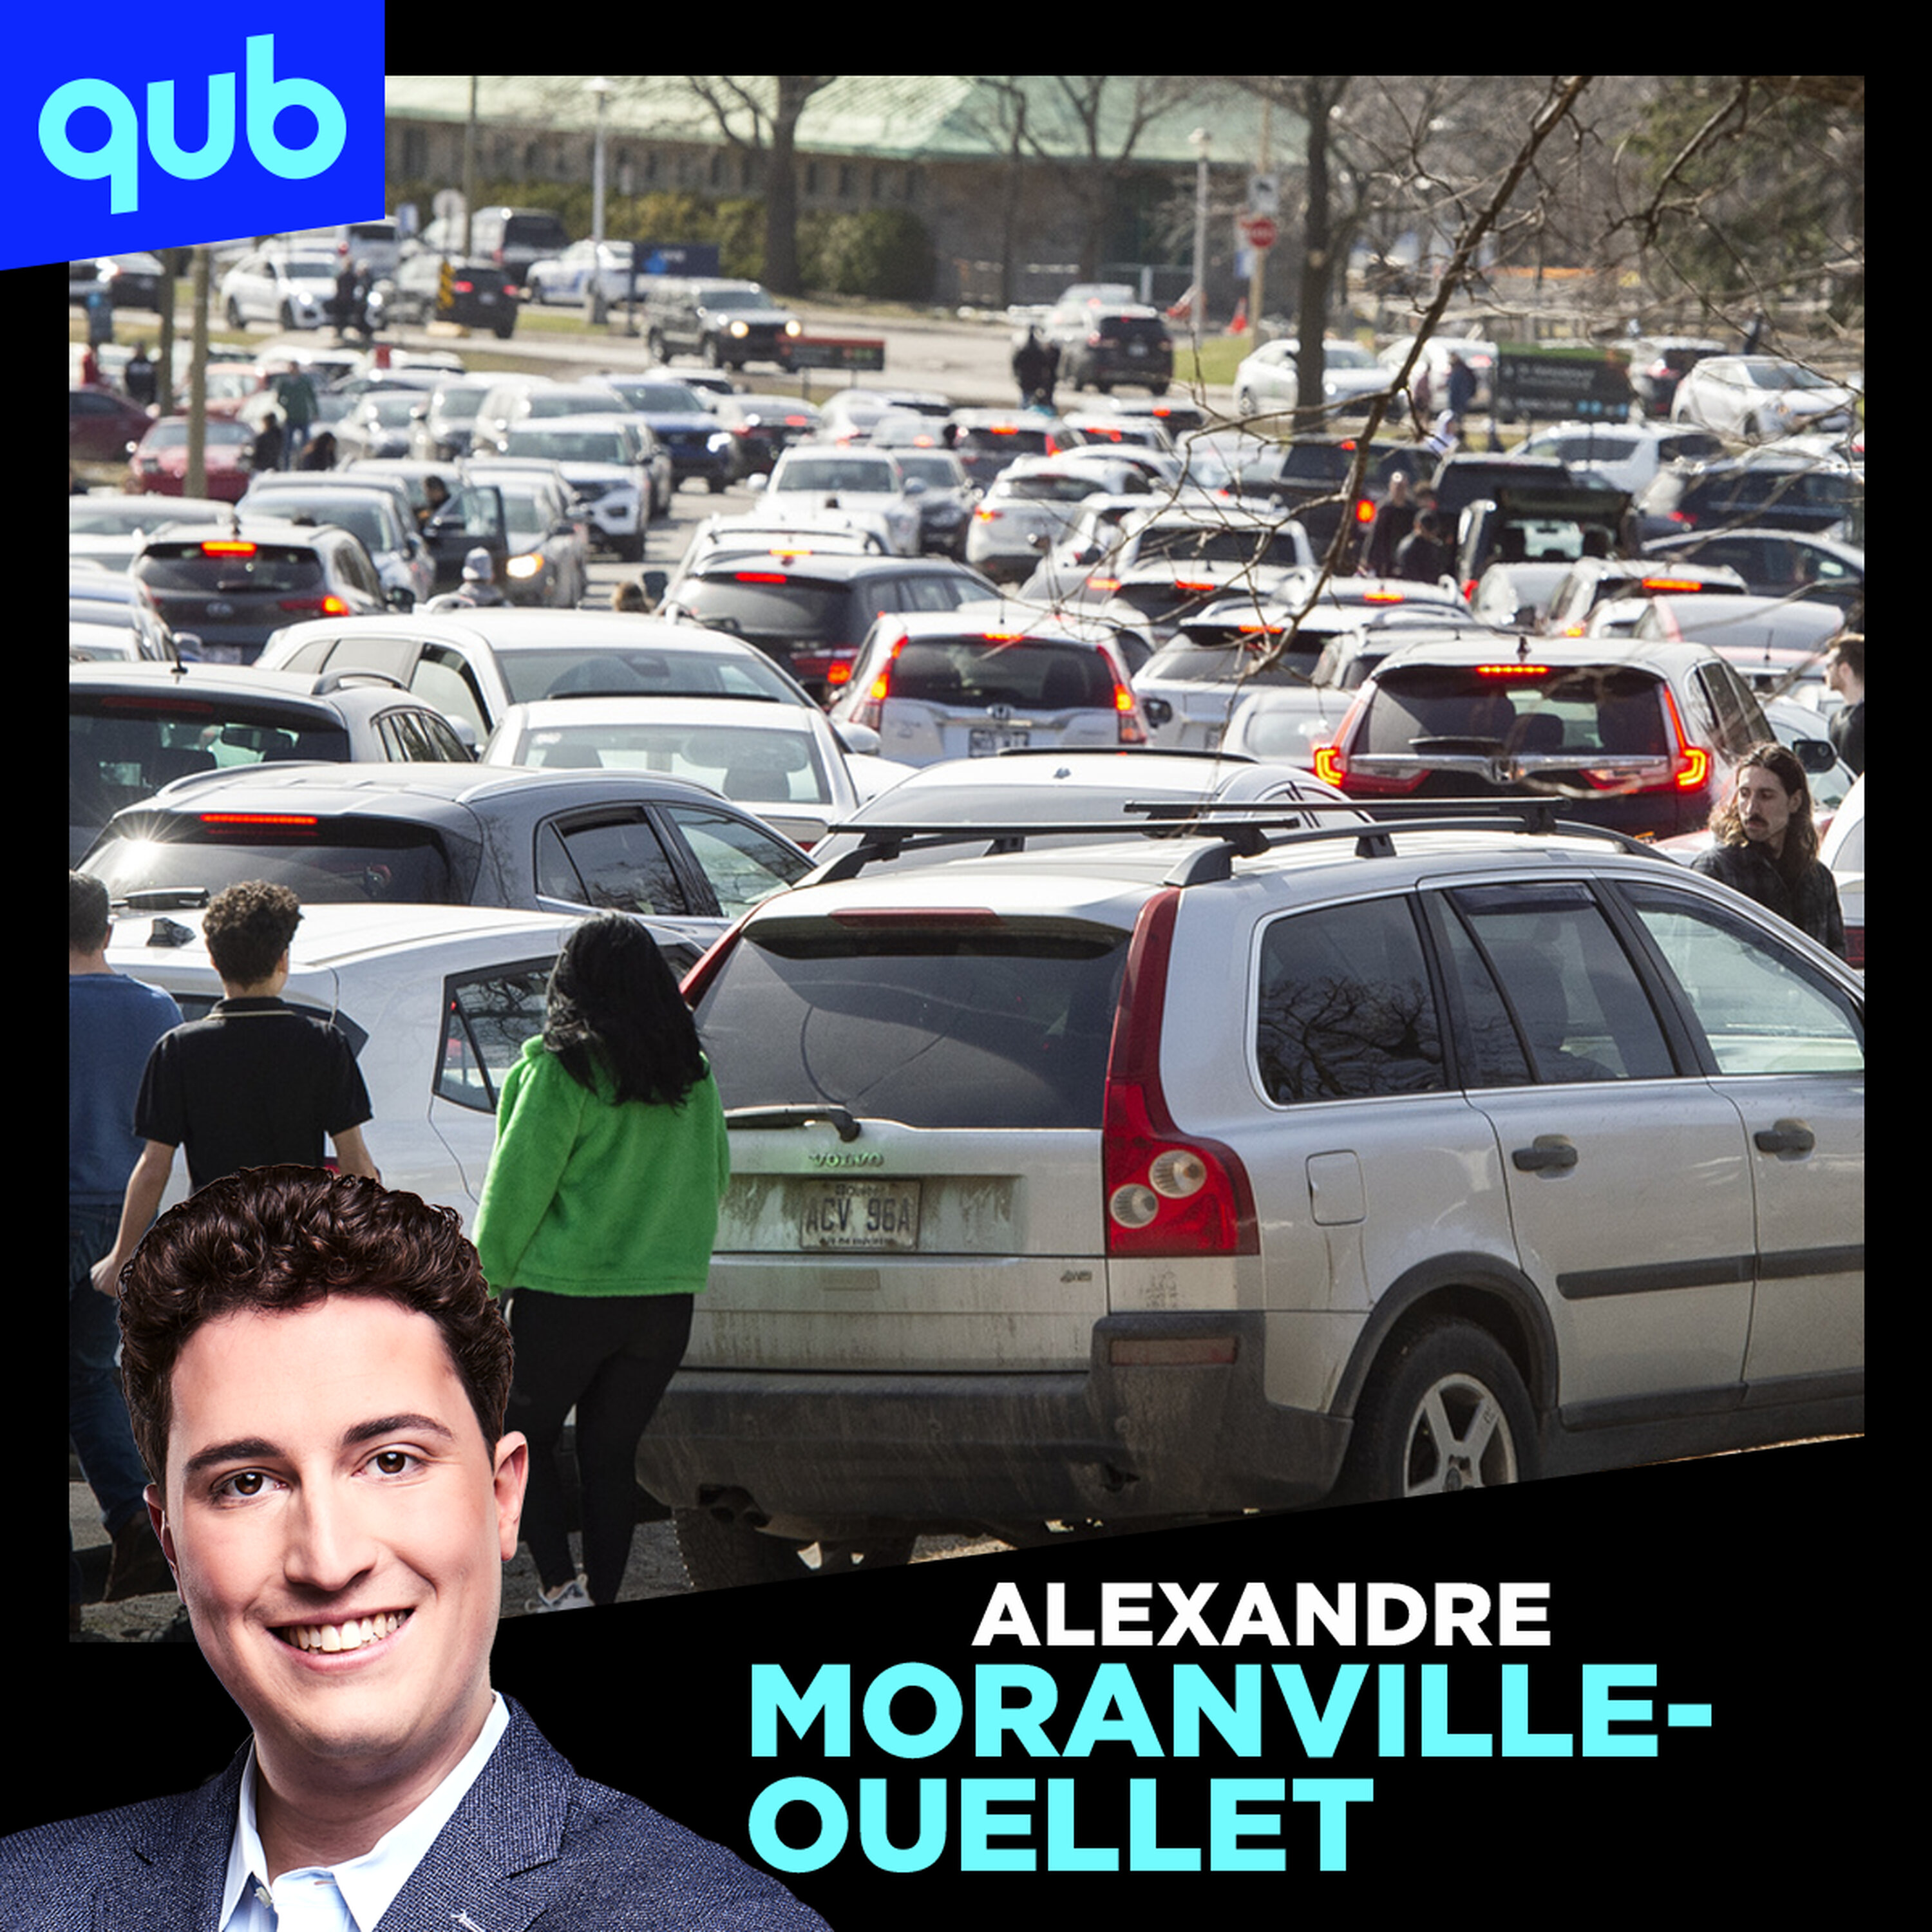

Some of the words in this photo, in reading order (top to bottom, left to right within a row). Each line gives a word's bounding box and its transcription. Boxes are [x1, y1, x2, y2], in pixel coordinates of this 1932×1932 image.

[809, 1152, 885, 1168] VOLVO
[806, 1197, 851, 1233] ACV
[866, 1197, 910, 1233] 96A
